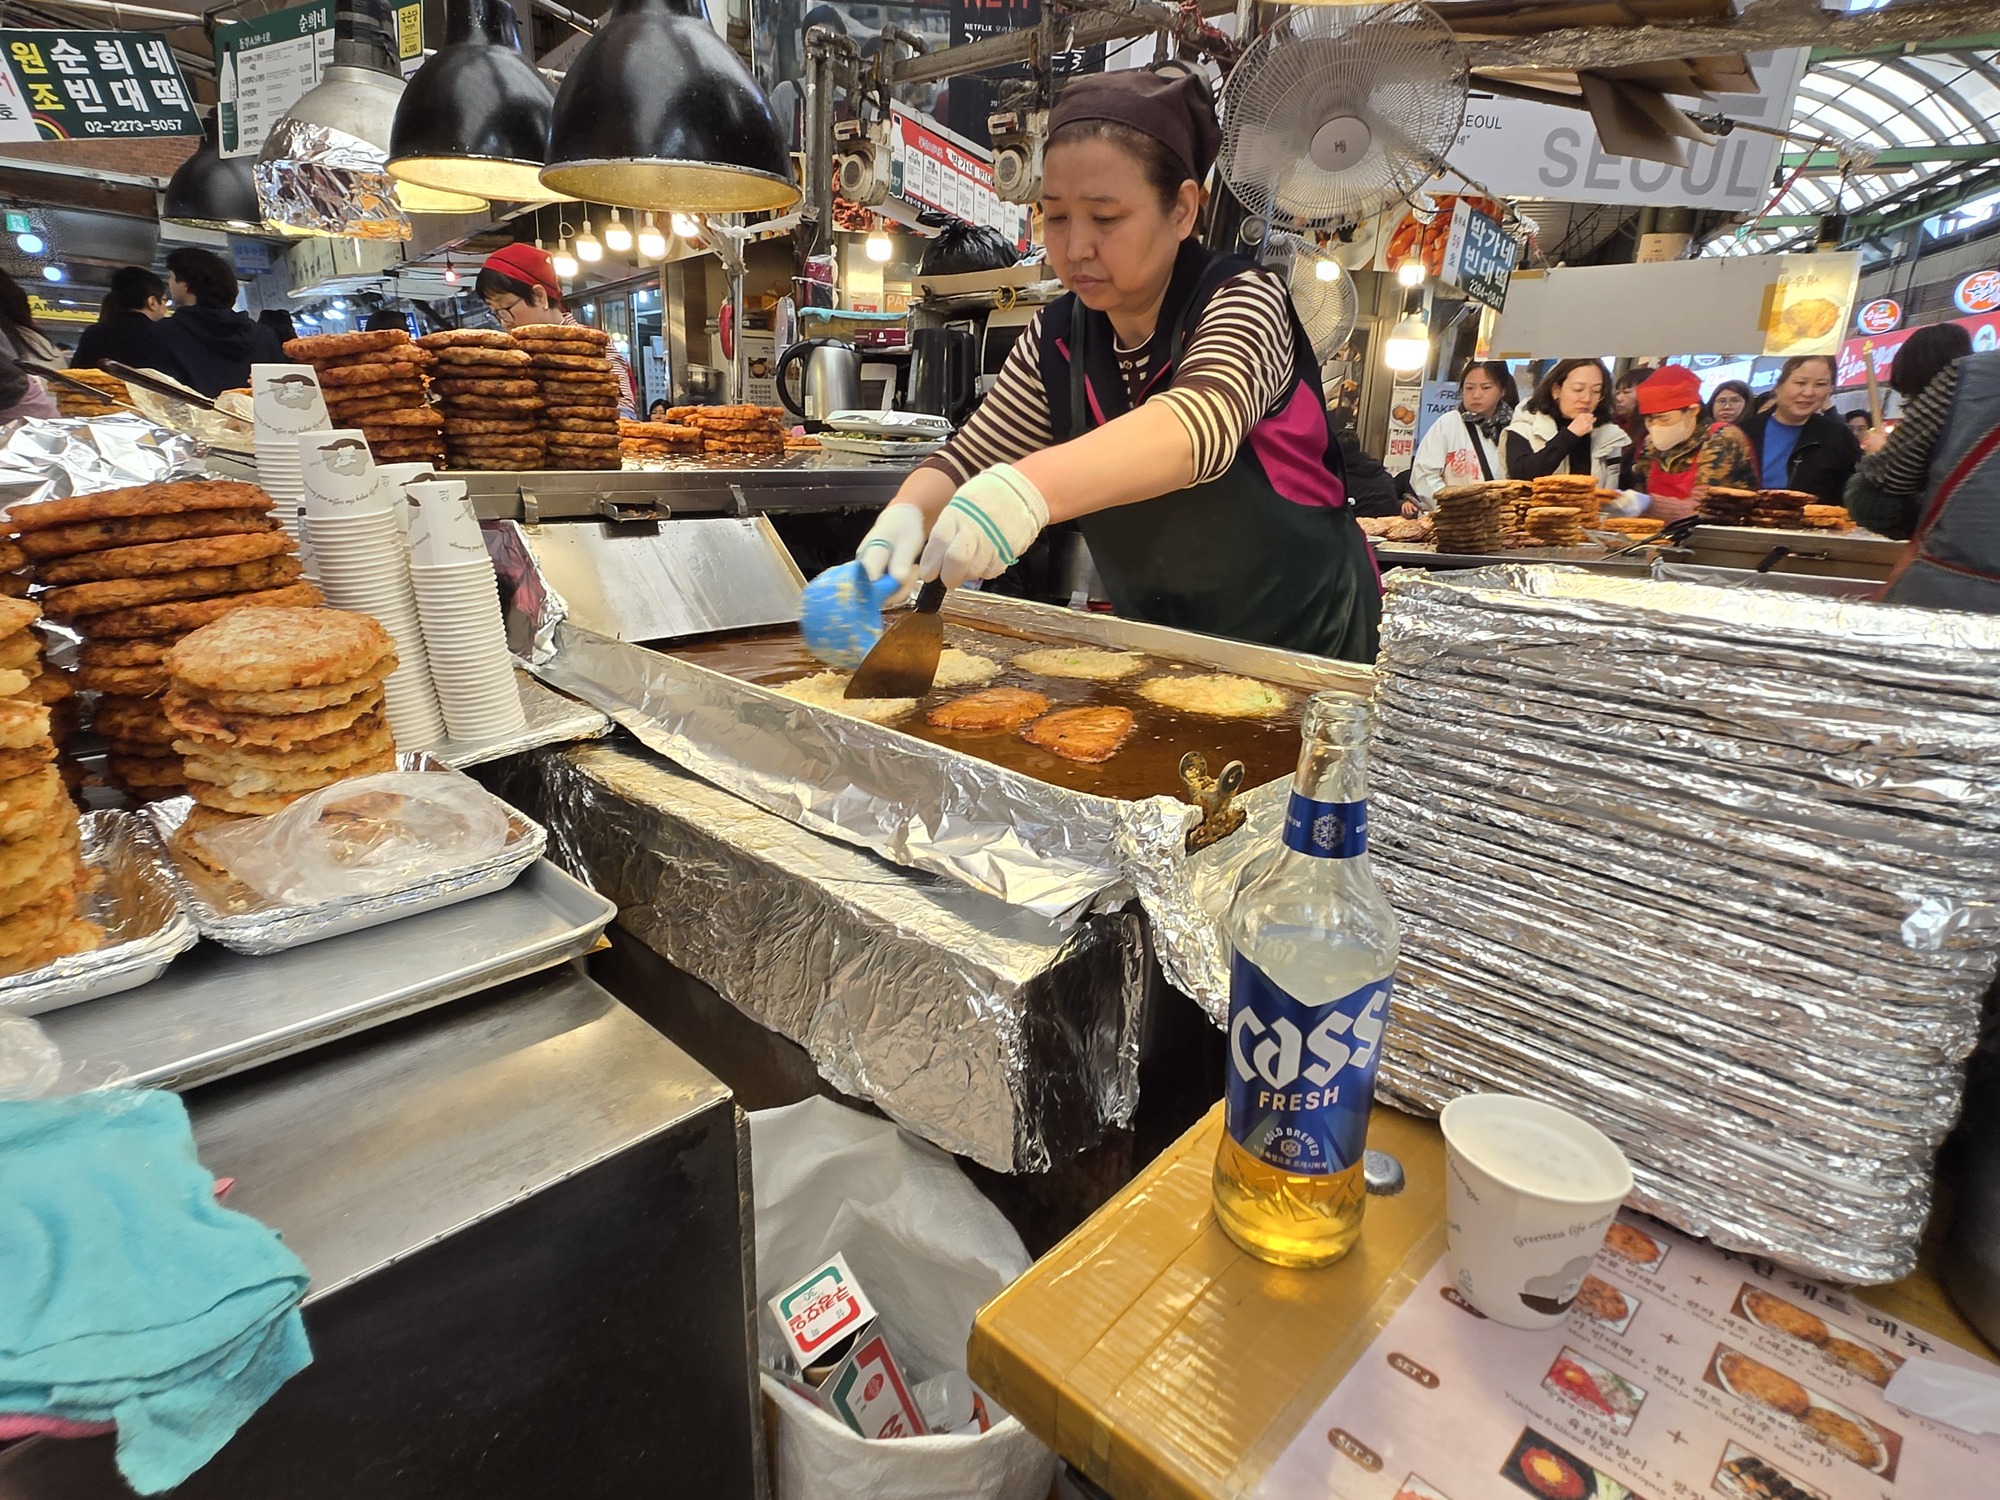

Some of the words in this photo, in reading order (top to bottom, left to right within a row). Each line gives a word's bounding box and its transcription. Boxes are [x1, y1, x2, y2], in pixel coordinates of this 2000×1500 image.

[298, 8, 326, 33] 순희네
[964, 23, 993, 32] NETFLIX
[50, 38, 175, 75] 순희네
[63, 78, 190, 113] 빈대떡
[85, 119, 182, 133] 02-2273-5057
[951, 154, 976, 177] 박가네
[1538, 127, 1758, 198] SEOUL
[1470, 216, 1516, 268] 박가네
[1464, 245, 1509, 294] 빈대떡
[1258, 1086, 1340, 1112] FRESH
[1263, 1127, 1284, 1146] COLD
[1286, 1127, 1320, 1157] BREWED
[1513, 1231, 1566, 1248] Greentea
[787, 1286, 850, 1334] 쿠킹호일
[1865, 1314, 1936, 1354] 메뉴
[1394, 1357, 1421, 1377] SET
[1420, 1373, 1431, 1383] 4
[1336, 1434, 1364, 1457] SET
[1918, 1420, 1980, 1455] 17,000
